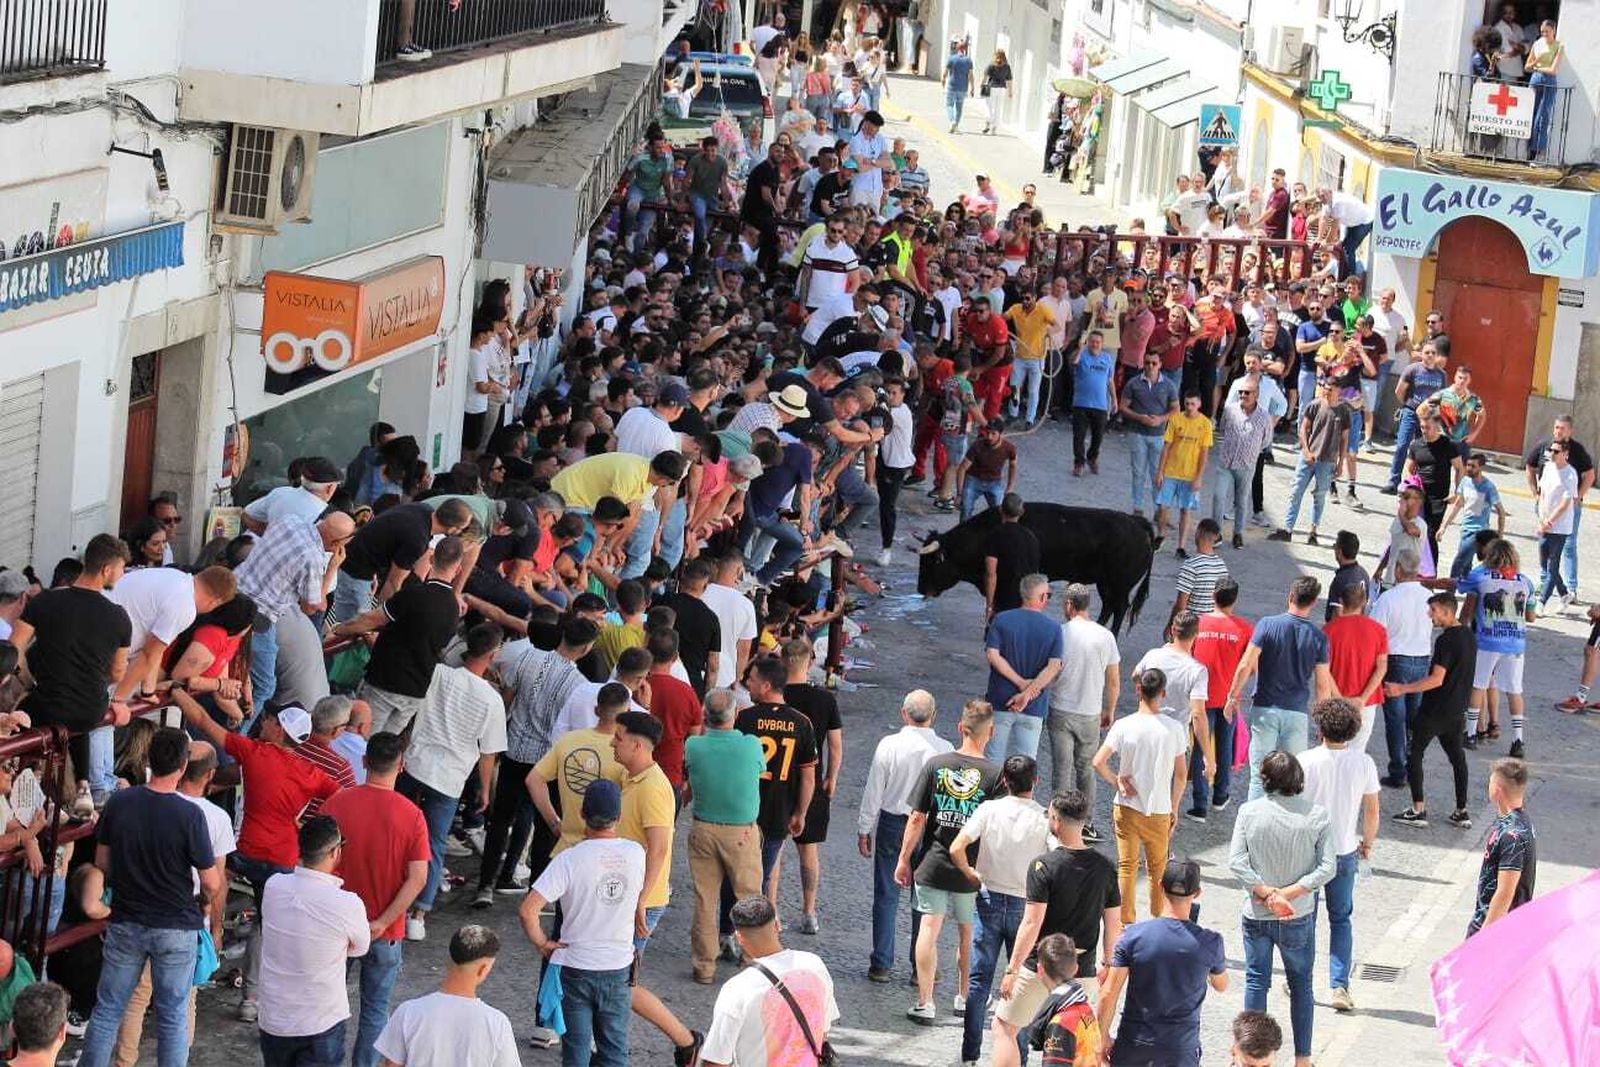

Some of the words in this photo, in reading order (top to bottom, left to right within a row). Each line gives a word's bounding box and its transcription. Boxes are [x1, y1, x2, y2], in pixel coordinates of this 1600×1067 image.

[1471, 114, 1512, 126] PUESTO
[1516, 119, 1530, 128] DE
[1379, 192, 1413, 232] El
[1422, 182, 1502, 214] Gallo
[1507, 193, 1582, 250] Azul
[1375, 235, 1422, 250] DEPORTES
[0, 261, 49, 303] BAZAR
[65, 247, 110, 287] CEUTA
[276, 290, 346, 313] VISTALIA
[368, 286, 431, 342] VISTALIA
[757, 718, 795, 732] DYBALA
[759, 735, 796, 781] 21
